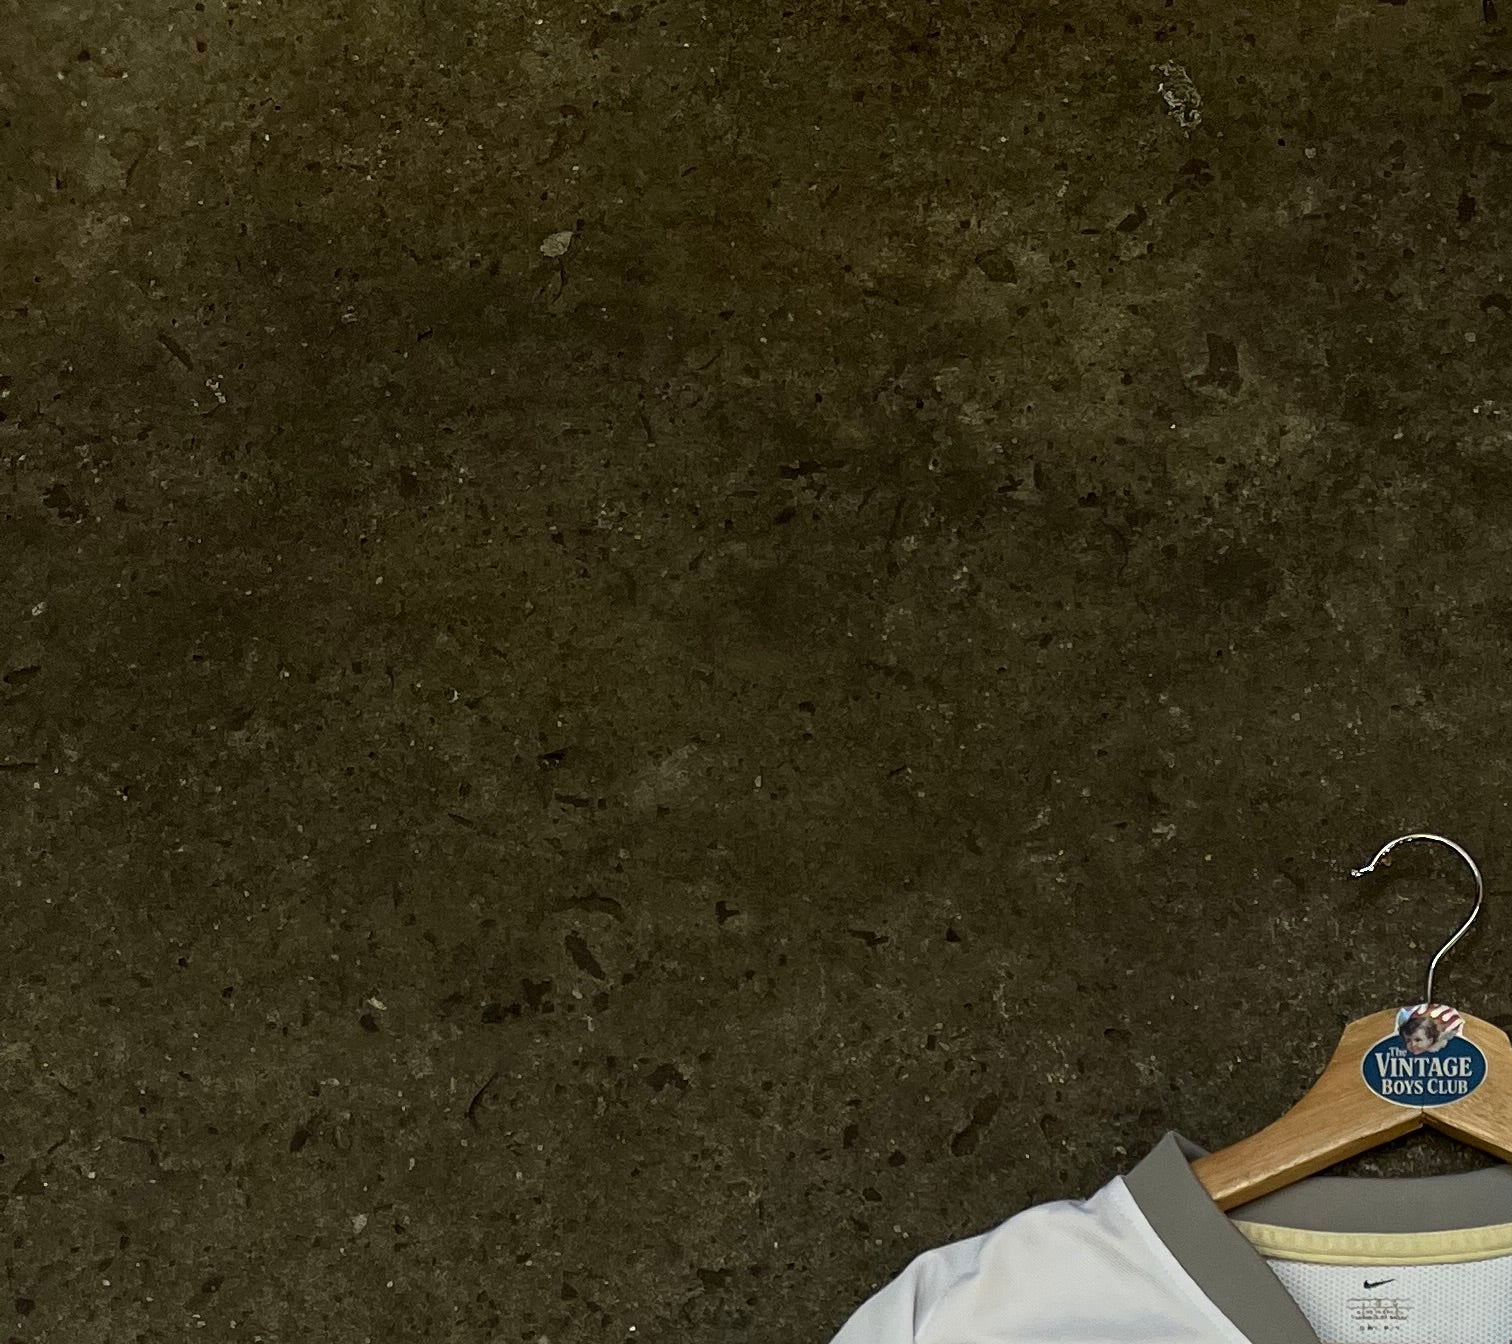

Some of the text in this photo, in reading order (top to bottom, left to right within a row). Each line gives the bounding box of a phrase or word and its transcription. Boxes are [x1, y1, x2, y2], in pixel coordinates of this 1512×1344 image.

[1389, 1047, 1408, 1057] The
[1375, 1052, 1472, 1077] VINTAGE
[1381, 1078, 1468, 1095] BOYS CLUB
